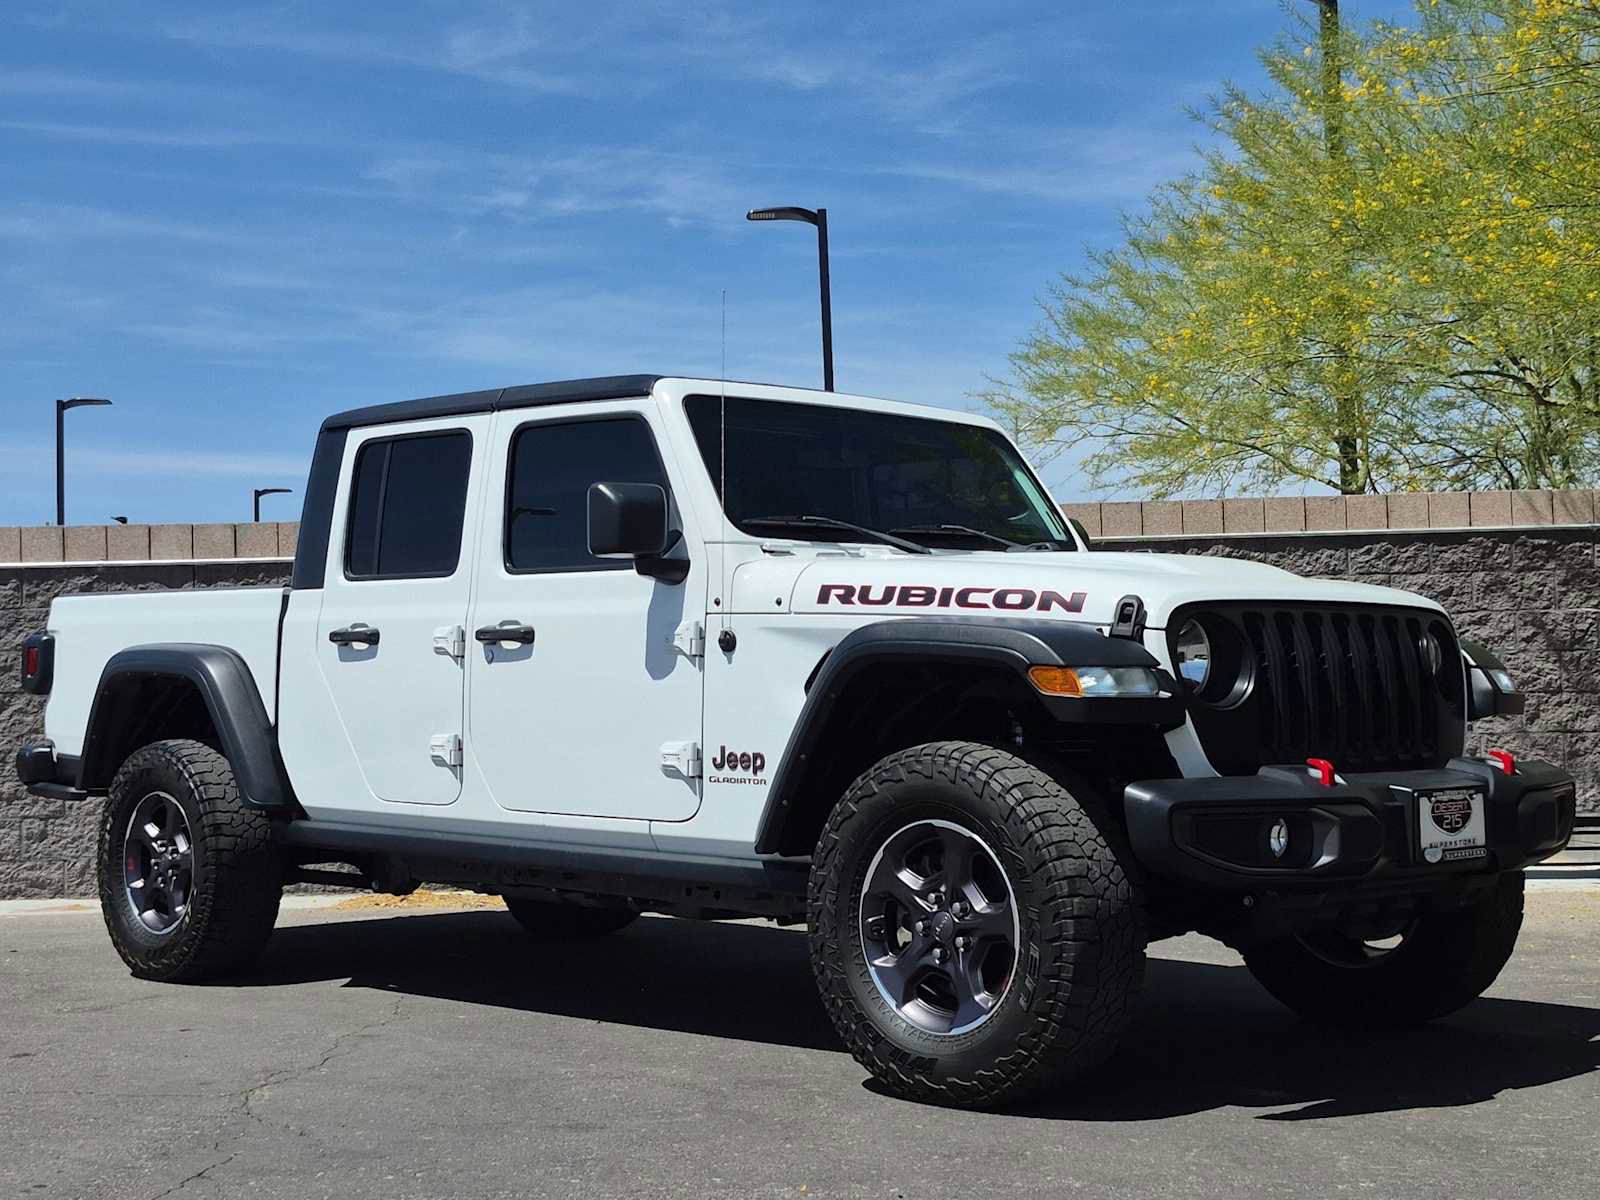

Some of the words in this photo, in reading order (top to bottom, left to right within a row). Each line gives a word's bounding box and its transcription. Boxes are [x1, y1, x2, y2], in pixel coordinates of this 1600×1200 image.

[816, 584, 1088, 613] RUBICON
[712, 745, 766, 776] Jeep
[709, 776, 767, 785] GLADIATOR
[1434, 801, 1468, 813] DESERT
[1442, 814, 1463, 829] 215
[1429, 838, 1476, 848] SUPERSTORE
